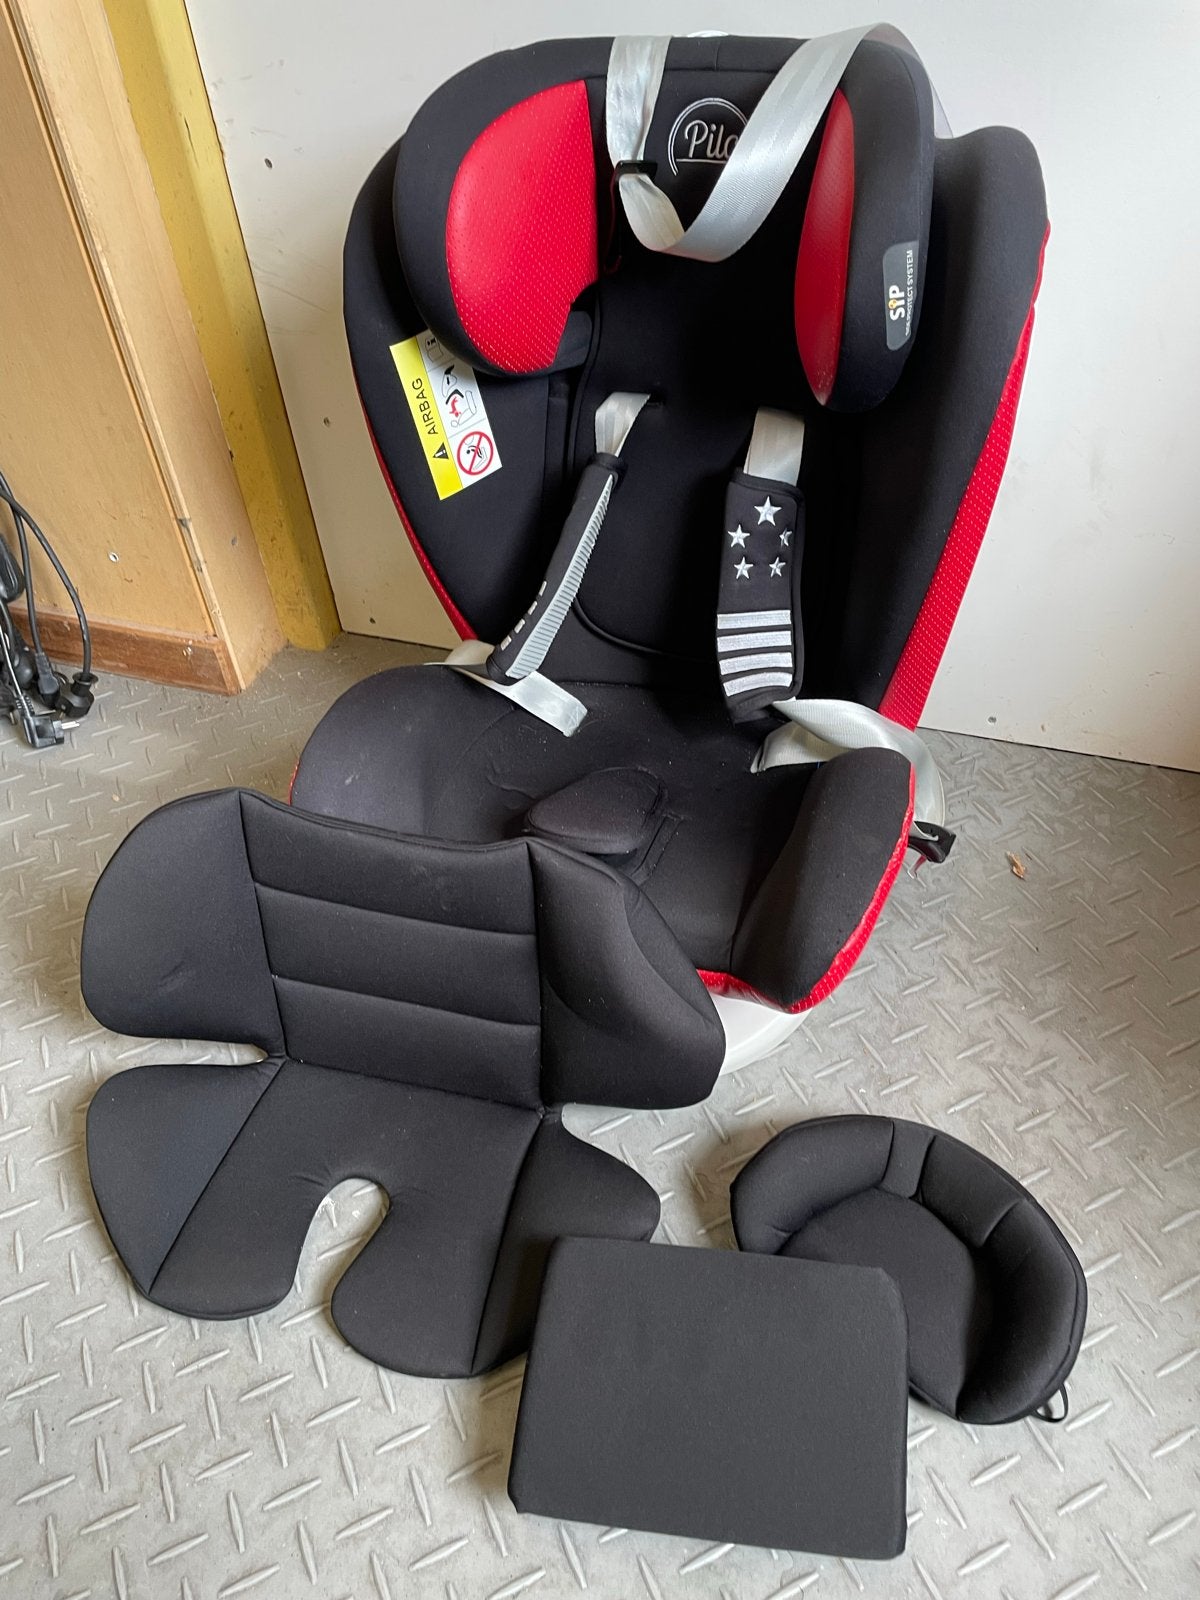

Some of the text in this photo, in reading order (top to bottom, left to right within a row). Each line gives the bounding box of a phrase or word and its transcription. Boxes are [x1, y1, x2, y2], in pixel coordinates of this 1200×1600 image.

[684, 119, 739, 159] Pilo
[906, 249, 914, 285] SYSTEM
[411, 377, 439, 436] AIRBAG
